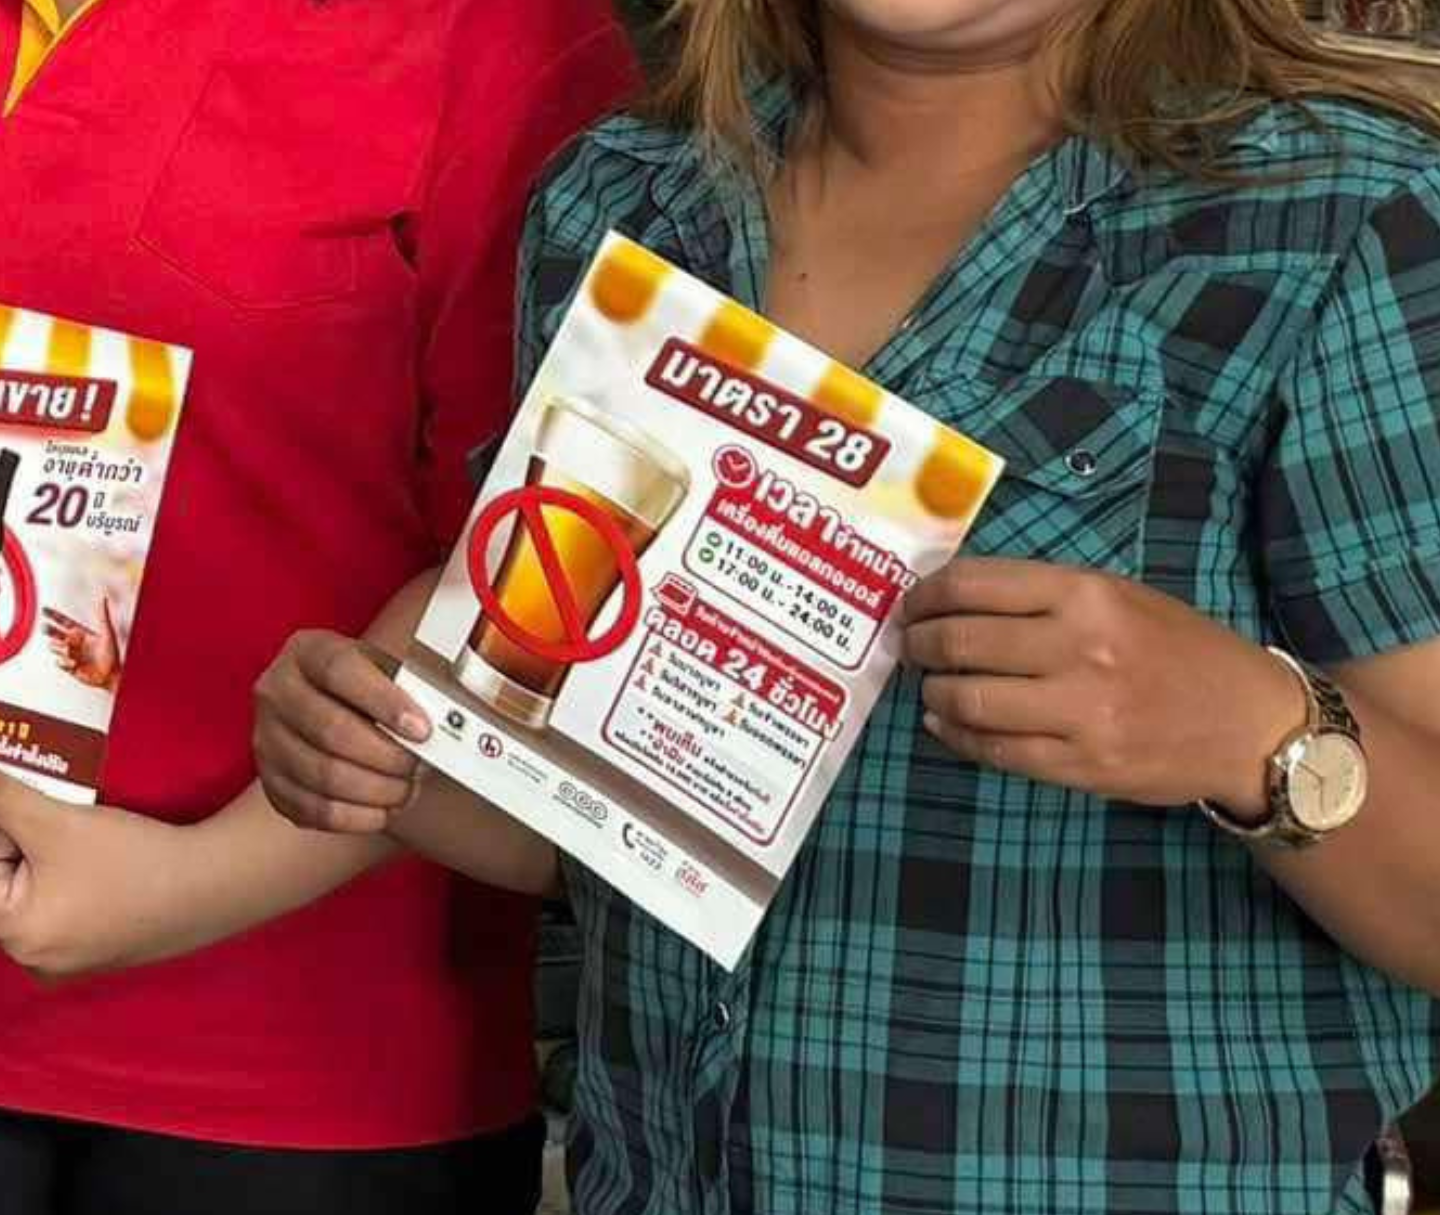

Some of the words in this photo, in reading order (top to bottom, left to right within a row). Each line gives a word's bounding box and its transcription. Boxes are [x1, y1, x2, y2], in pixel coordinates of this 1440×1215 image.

[81, 384, 100, 422] !
[660, 348, 802, 441] มาตรา
[805, 420, 873, 476] 28
[25, 481, 92, 529] 20
[644, 602, 720, 664] ตลอด
[720, 644, 768, 693] 24
[766, 669, 845, 743] ชั่วโมง
